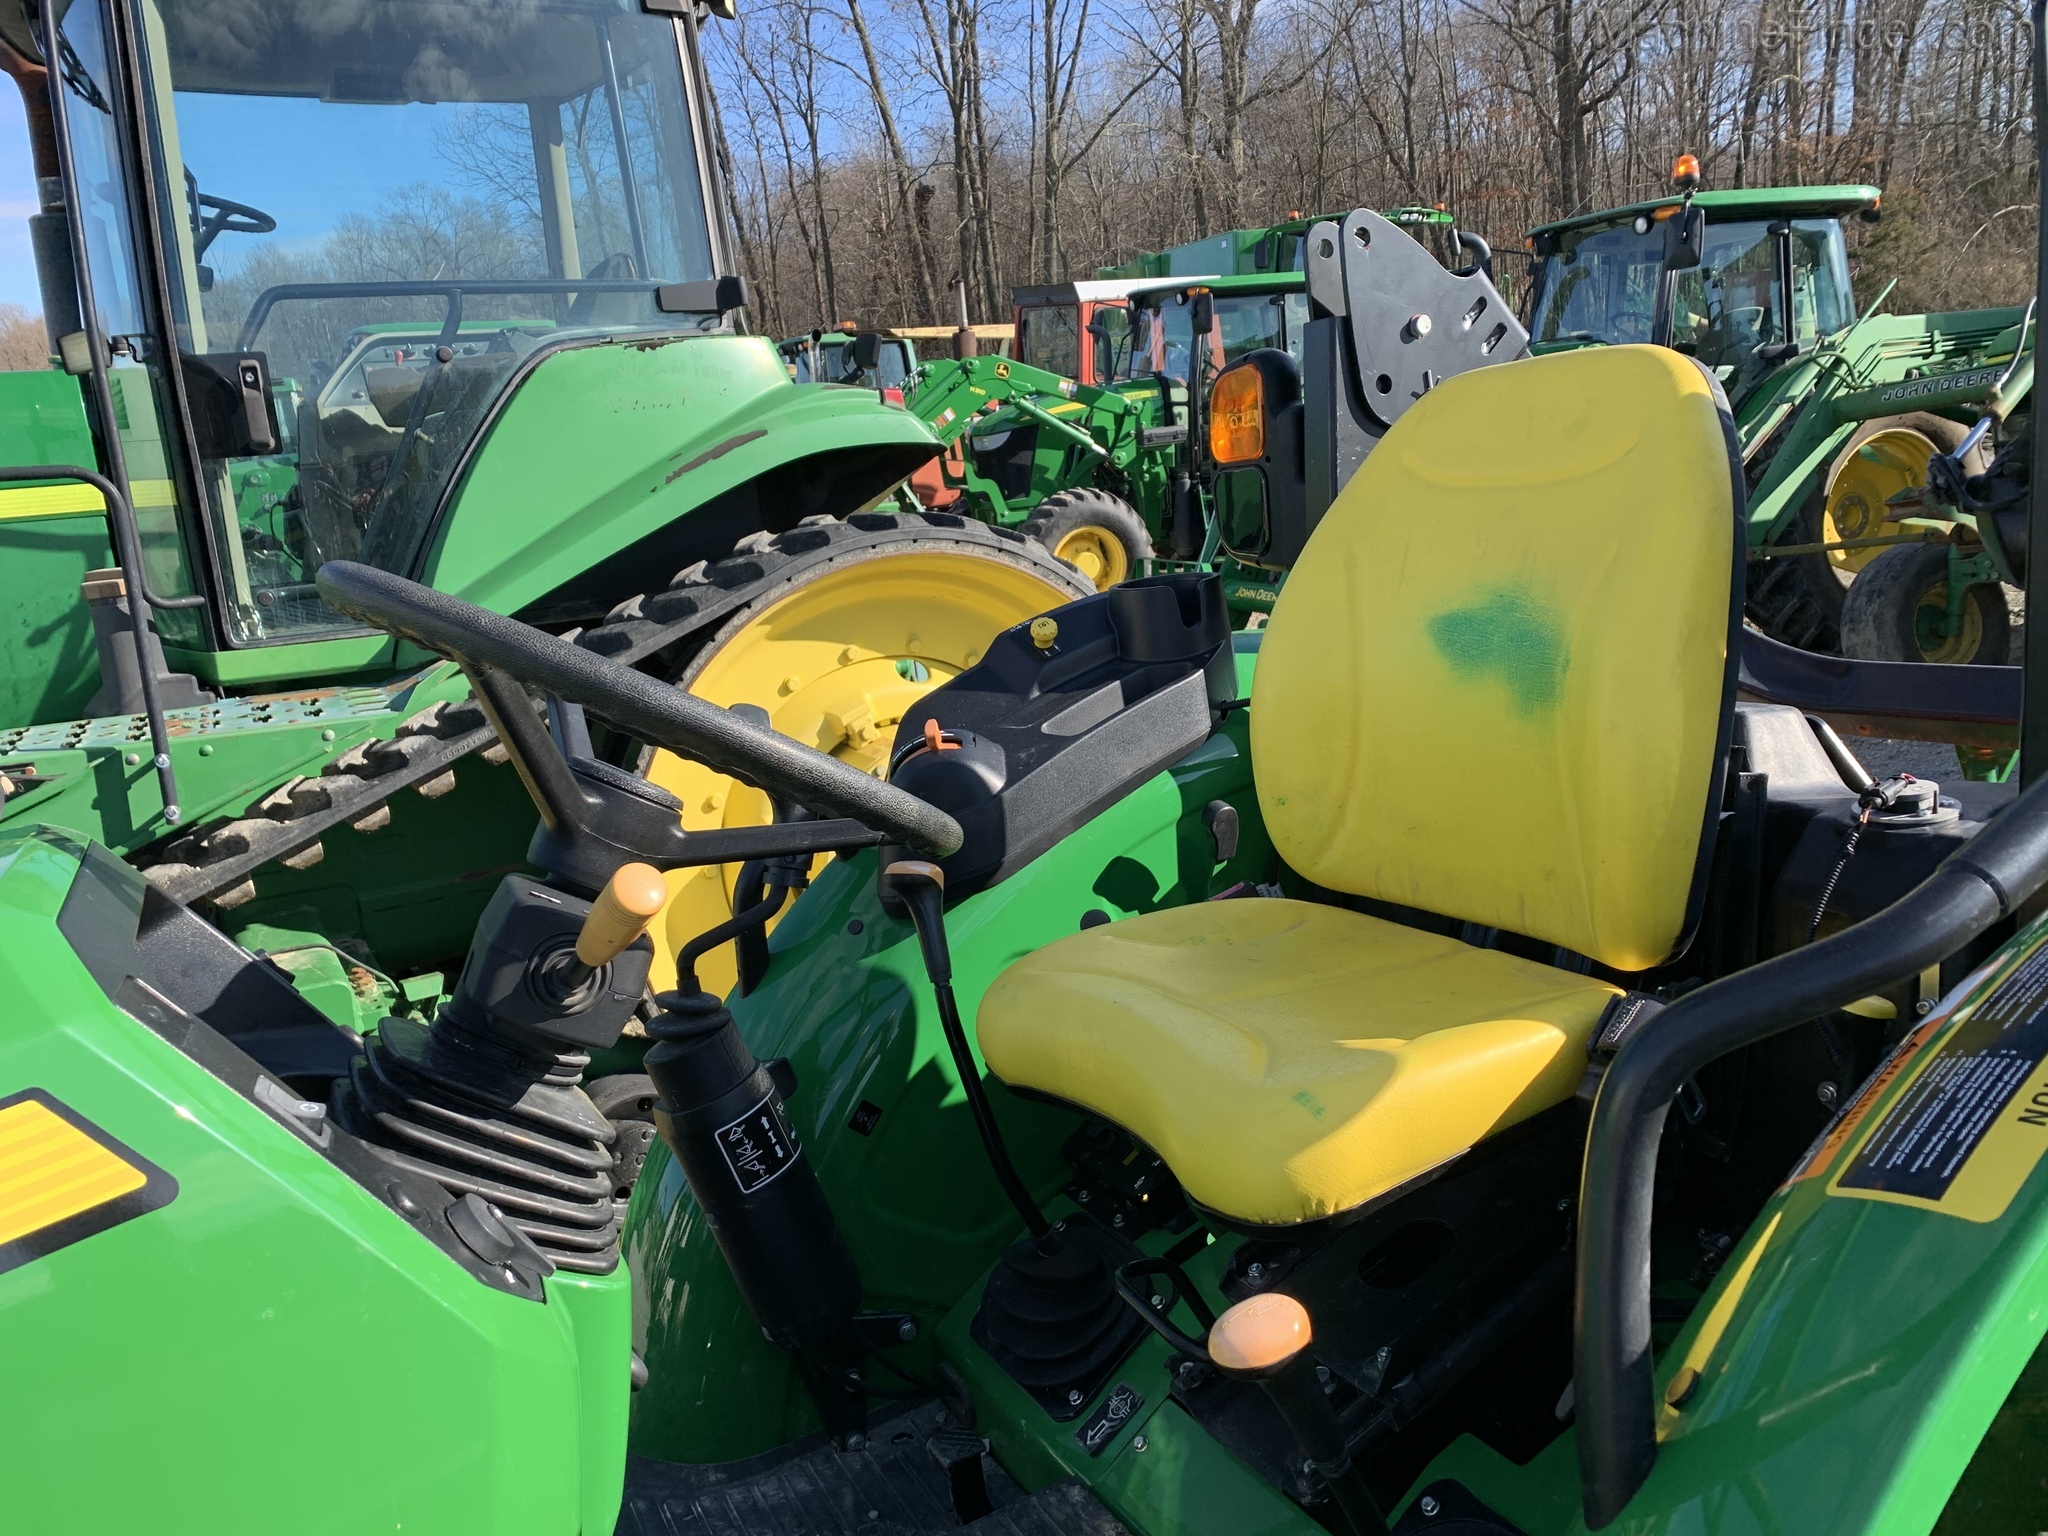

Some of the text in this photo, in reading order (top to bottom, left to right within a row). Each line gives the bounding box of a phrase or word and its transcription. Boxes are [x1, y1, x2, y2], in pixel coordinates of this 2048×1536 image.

[1881, 370, 2005, 402] JOHN DEERE
[1235, 586, 1256, 599] JOHN
